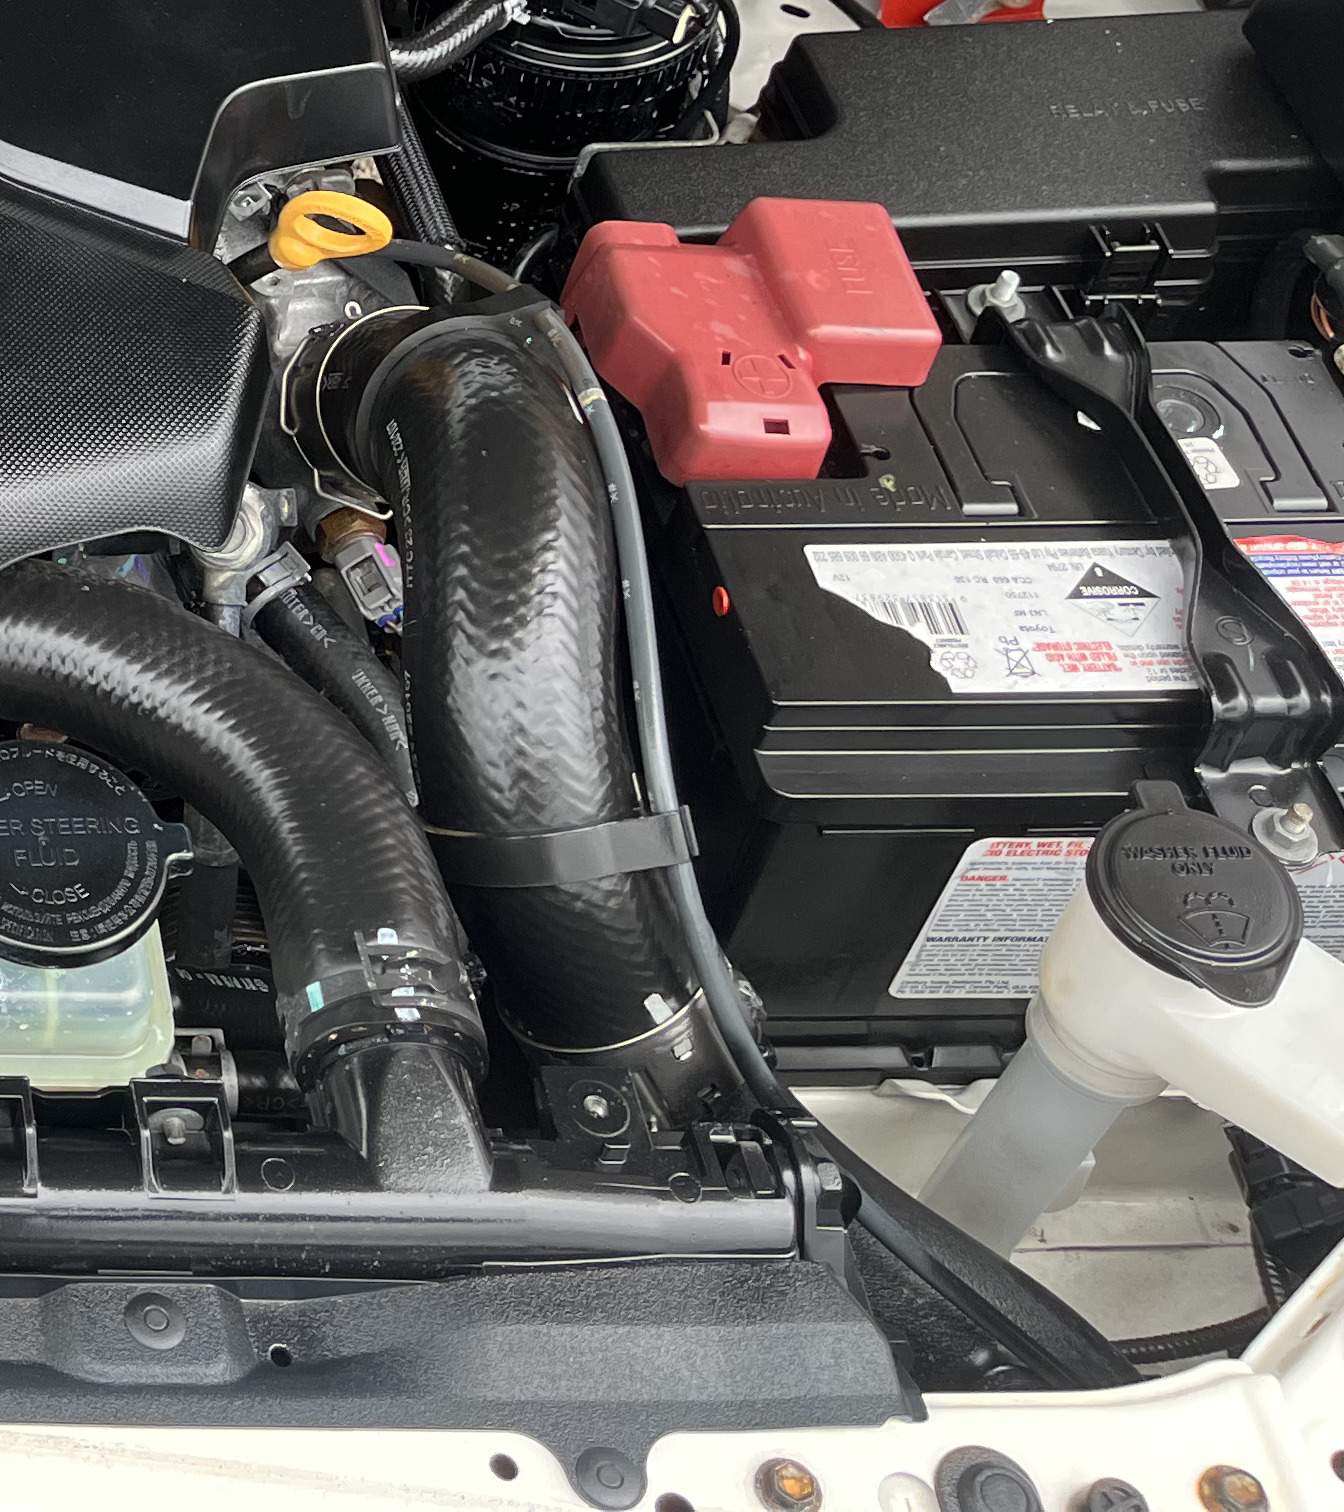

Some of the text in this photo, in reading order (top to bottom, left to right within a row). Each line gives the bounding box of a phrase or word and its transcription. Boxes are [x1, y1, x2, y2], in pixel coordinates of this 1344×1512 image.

[1079, 585, 1140, 597] CORROSIVE
[1018, 624, 1056, 634] Toyota
[999, 636, 1020, 646] Pb
[11, 777, 59, 798] OPEN
[29, 816, 141, 837] STEERING
[13, 846, 81, 868] FLUID
[1004, 849, 1061, 857] ELECTRIC
[1121, 844, 1253, 861] WASHER FLUID
[1170, 861, 1215, 877] ONLY
[31, 882, 91, 905] CLOSE
[925, 935, 990, 943] WARRANTY
